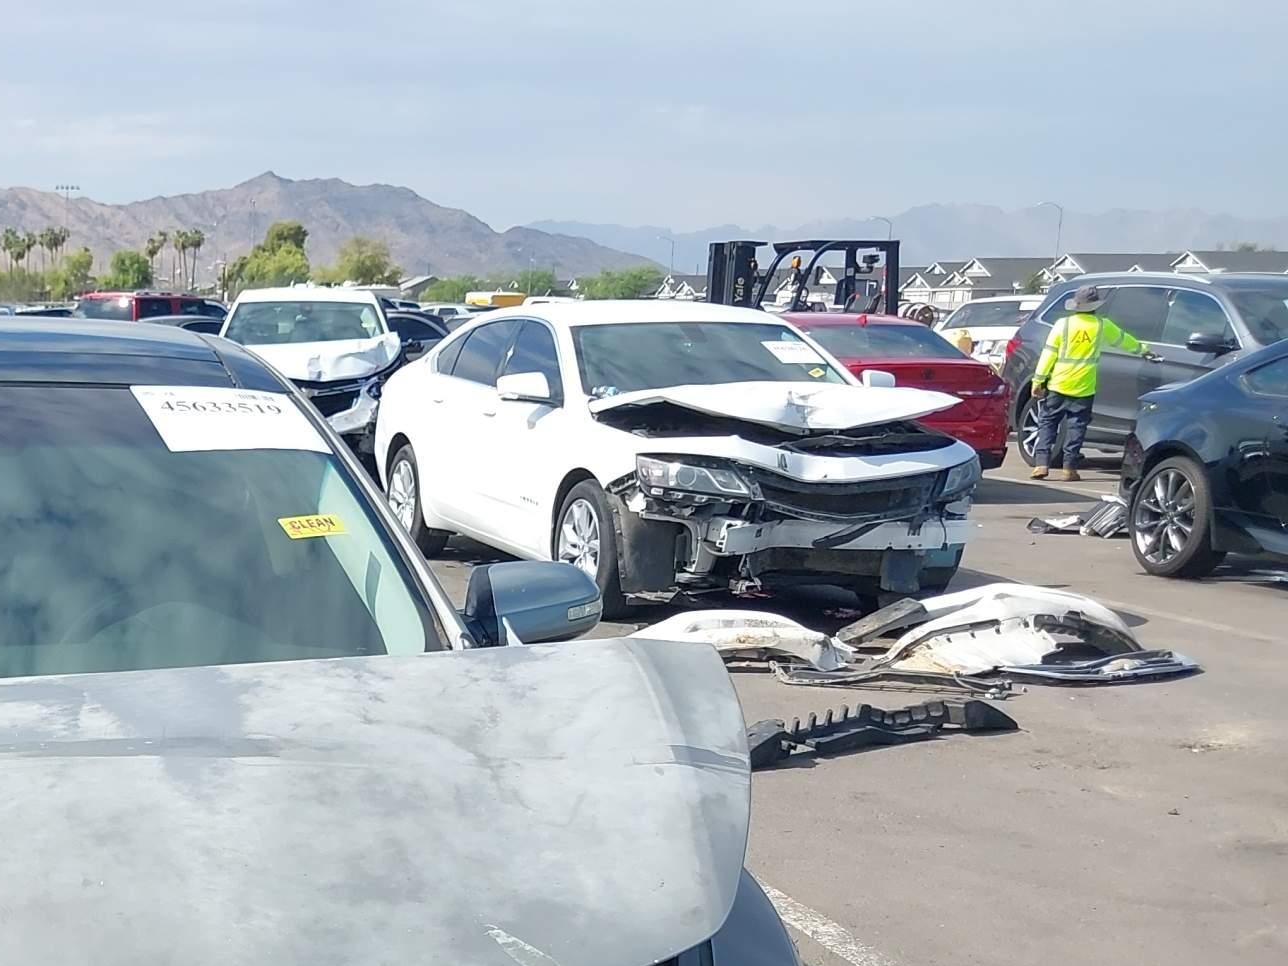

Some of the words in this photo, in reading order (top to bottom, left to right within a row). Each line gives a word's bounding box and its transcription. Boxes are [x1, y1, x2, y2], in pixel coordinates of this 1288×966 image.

[734, 277, 745, 302] Yale
[160, 400, 282, 415] 45633519
[289, 517, 336, 530] CLEAN
